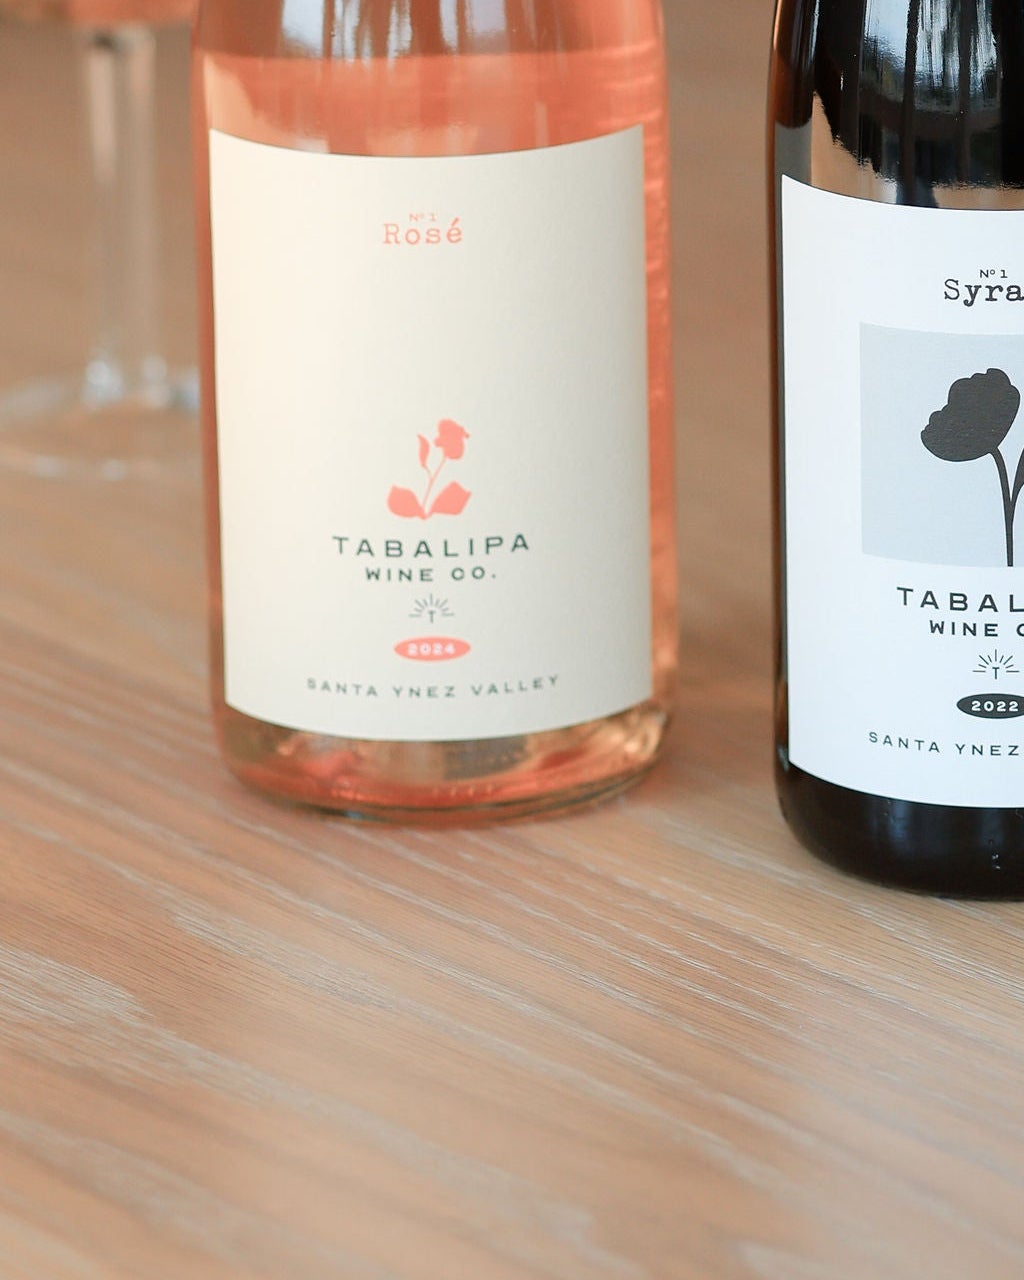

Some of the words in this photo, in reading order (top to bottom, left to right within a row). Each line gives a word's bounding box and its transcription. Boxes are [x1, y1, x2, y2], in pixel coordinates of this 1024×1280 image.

[383, 217, 463, 245] Rosé
[333, 533, 530, 558] TABALIPA
[365, 568, 433, 582] WINE
[450, 565, 496, 582] CO.
[929, 619, 999, 638] WINE
[407, 642, 456, 656] 2024
[307, 677, 378, 697] SANTA
[392, 685, 455, 699] YNEZ
[471, 674, 559, 696] VALLEY
[970, 699, 1020, 713] 2022
[868, 731, 940, 753] SANTA
[955, 743, 1020, 757] YNEZ
